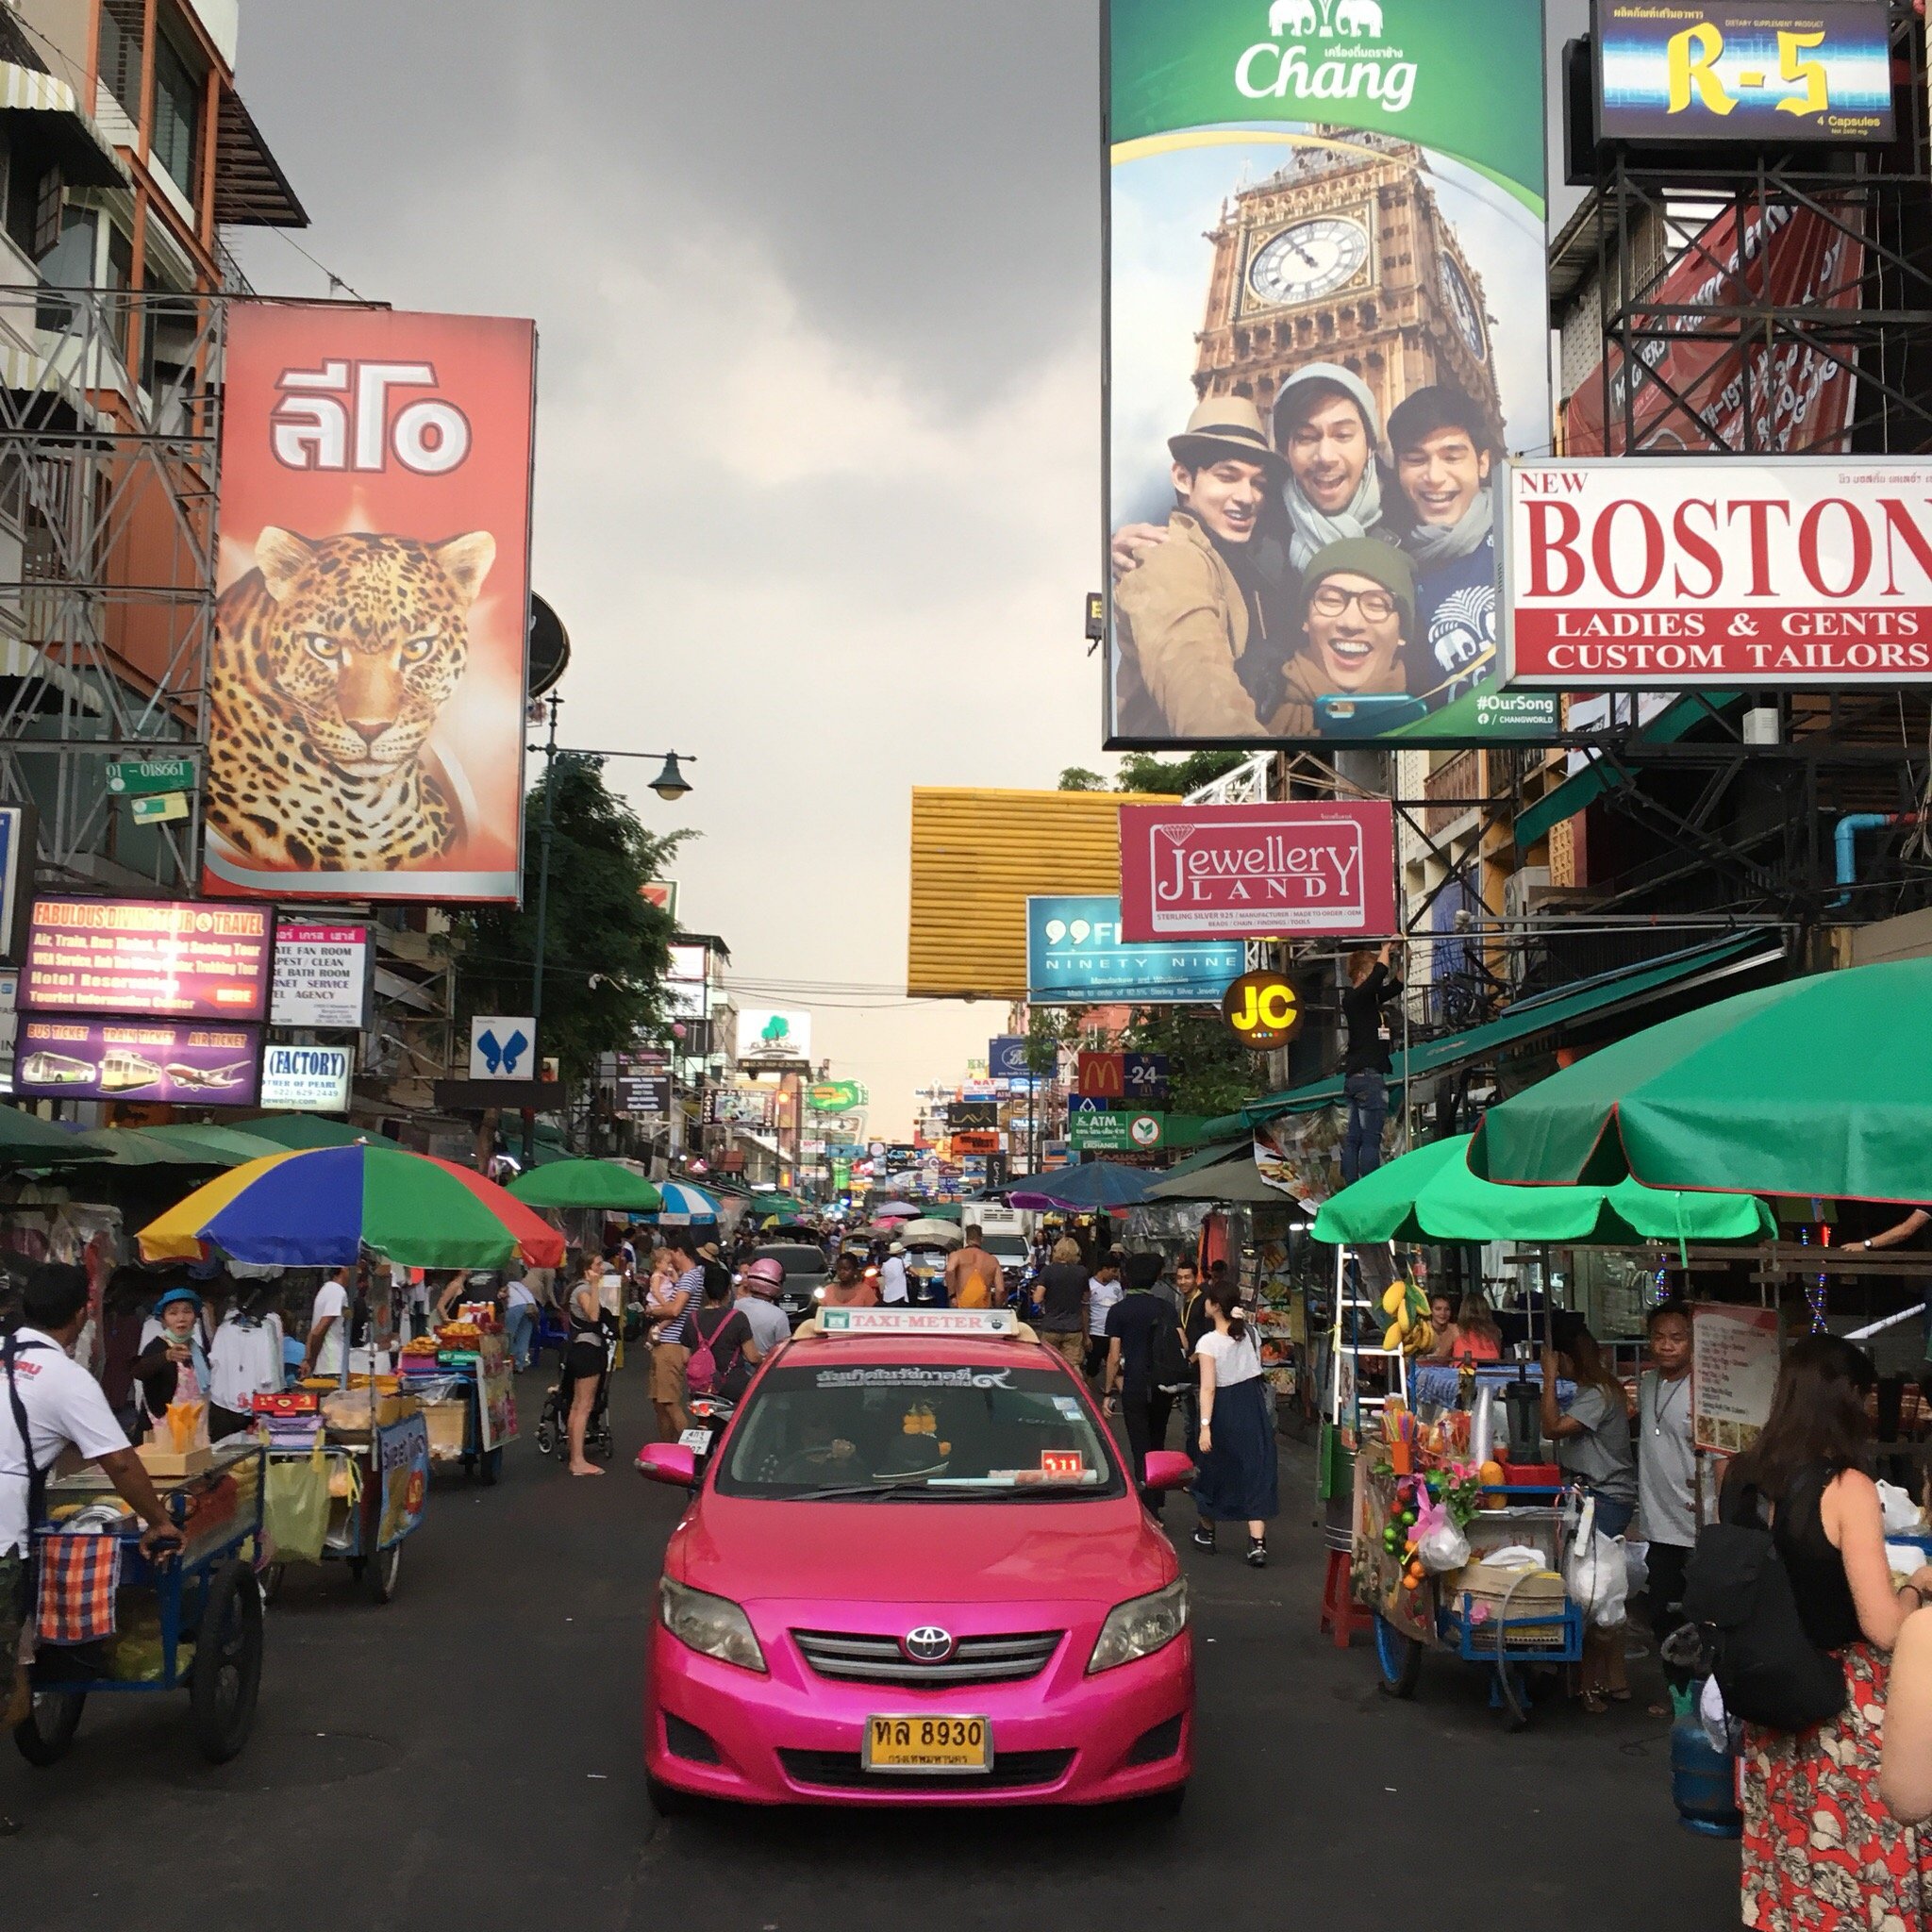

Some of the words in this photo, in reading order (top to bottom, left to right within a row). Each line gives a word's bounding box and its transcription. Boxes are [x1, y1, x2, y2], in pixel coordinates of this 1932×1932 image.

[1235, 42, 1418, 112] Chang
[1667, 22, 1829, 117] R-5
[1817, 116, 1824, 126] 4
[1828, 116, 1881, 128] Capsules
[270, 357, 473, 476] ลีโอ
[1521, 473, 1589, 494] NEW
[1520, 497, 1932, 600] BOSTON
[1554, 612, 1706, 638] LADIES
[1727, 612, 1759, 638] &
[1781, 611, 1919, 638] GENTS
[1547, 643, 1725, 670] CUSTOM
[1745, 642, 1930, 670] TAILORS
[1476, 696, 1554, 712] #OurSong
[1499, 715, 1554, 724] CHANGWORLD
[141, 762, 185, 777] 018661
[1191, 877, 1327, 901] LAND
[35, 903, 105, 928] FABULOUS
[214, 912, 264, 936] TRAVEL
[1157, 912, 1192, 921] STERLING
[297, 946, 316, 955] FAN
[321, 947, 352, 956] ROOM
[311, 958, 344, 967] CLEAN
[1045, 958, 1149, 970] NINETY
[1172, 957, 1237, 967] NINE
[31, 971, 75, 986] Hotel
[288, 968, 314, 977] BATH
[319, 969, 350, 978] ROOM
[307, 980, 349, 989] SERVICE
[295, 991, 335, 1000] AGENCY
[1231, 984, 1298, 1031] JC
[27, 1024, 50, 1039] BUS
[51, 1025, 89, 1041] TICKET
[104, 1027, 137, 1044] TRAIN
[138, 1029, 175, 1045] TICKET
[189, 1032, 209, 1046] AIR
[210, 1033, 246, 1048] TICKET
[269, 1050, 345, 1079] (FACTORY)
[1132, 1066, 1156, 1084] 24
[1090, 1116, 1117, 1126] ATM
[852, 1315, 983, 1329] TAXI-METER
[874, 1721, 910, 1746] ทล
[921, 1721, 981, 1746] 8930
